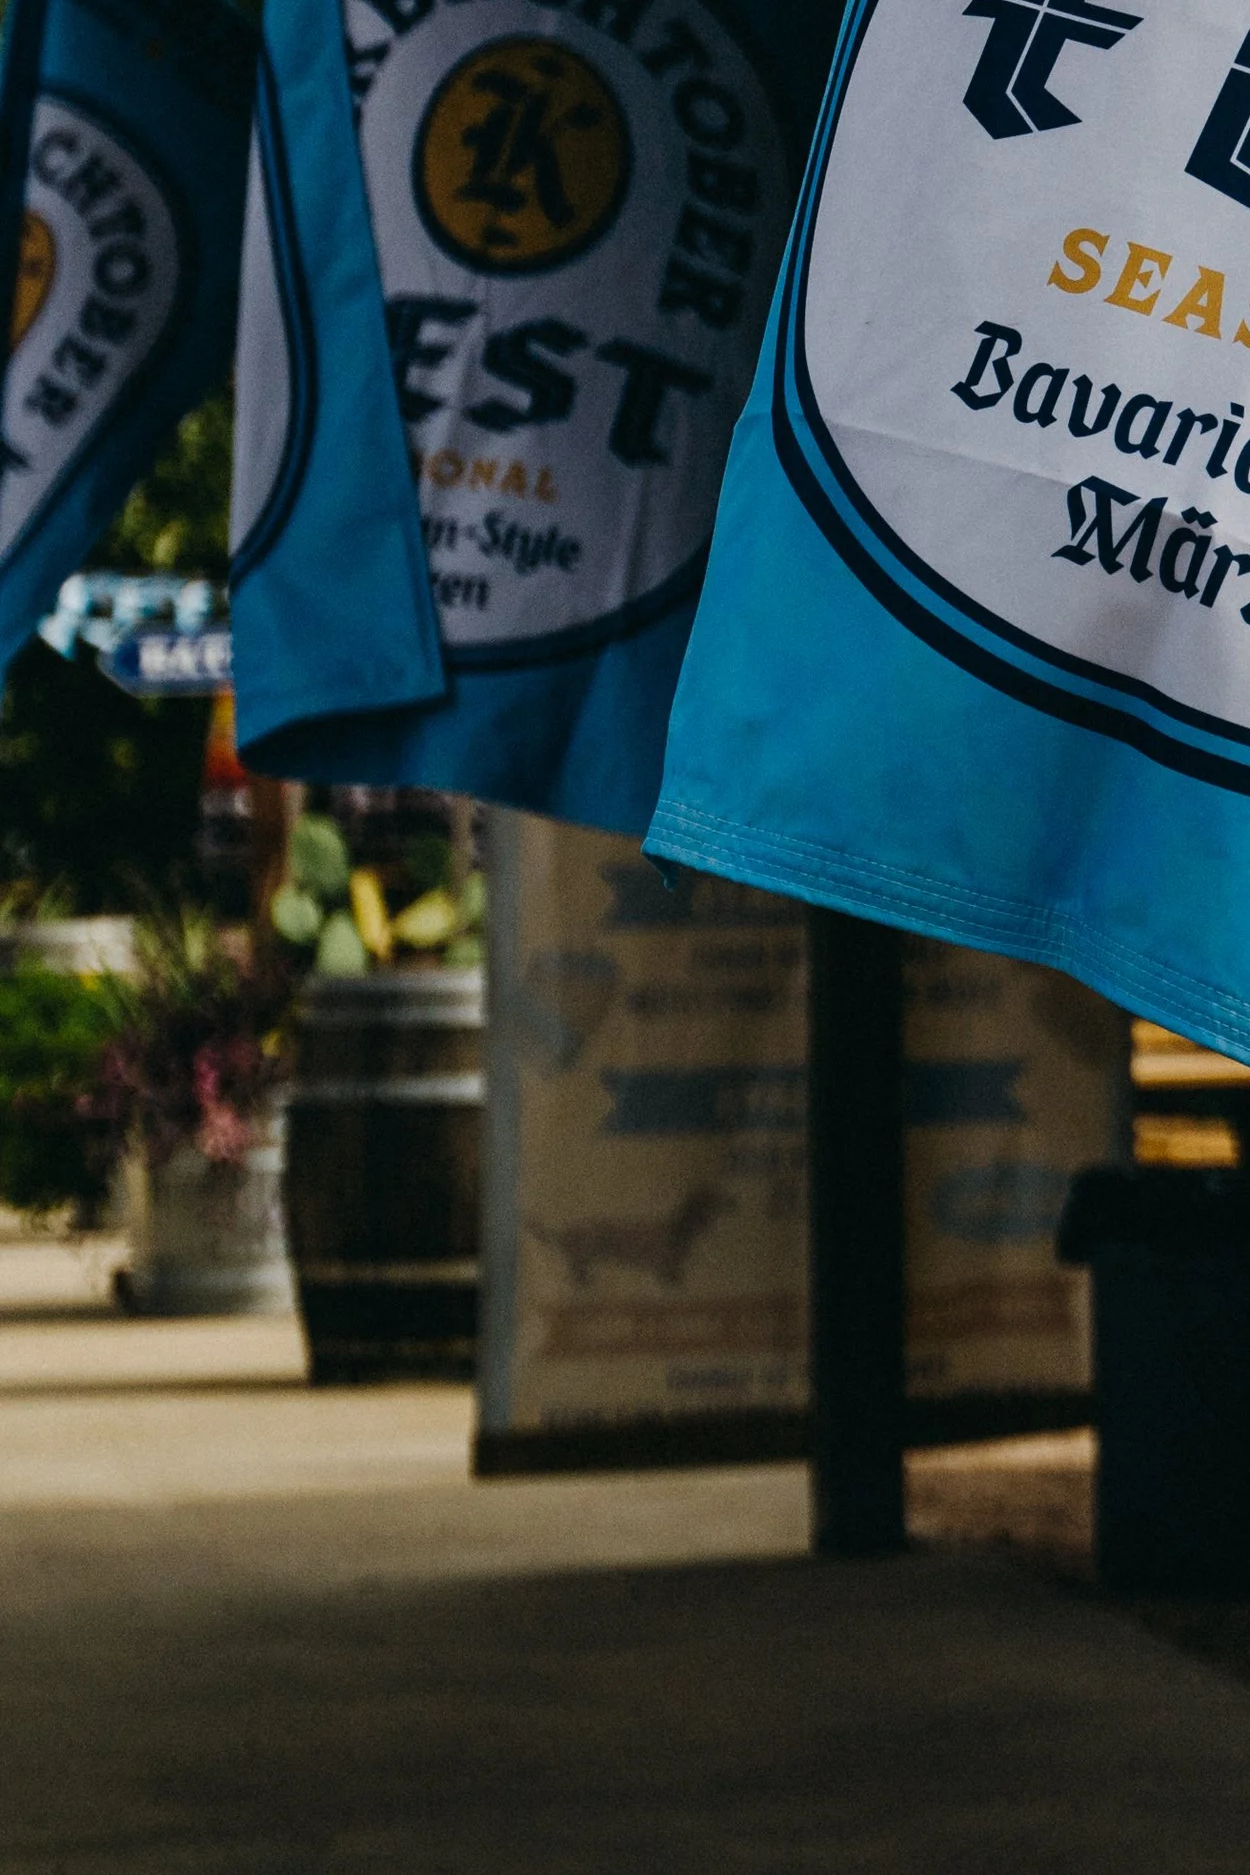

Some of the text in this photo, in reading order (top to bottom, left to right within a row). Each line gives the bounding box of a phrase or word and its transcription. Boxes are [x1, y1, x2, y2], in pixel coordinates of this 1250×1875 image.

[32, 131, 149, 428] CHTOBER
[388, 294, 712, 467] EST
[413, 450, 558, 503] ONAL
